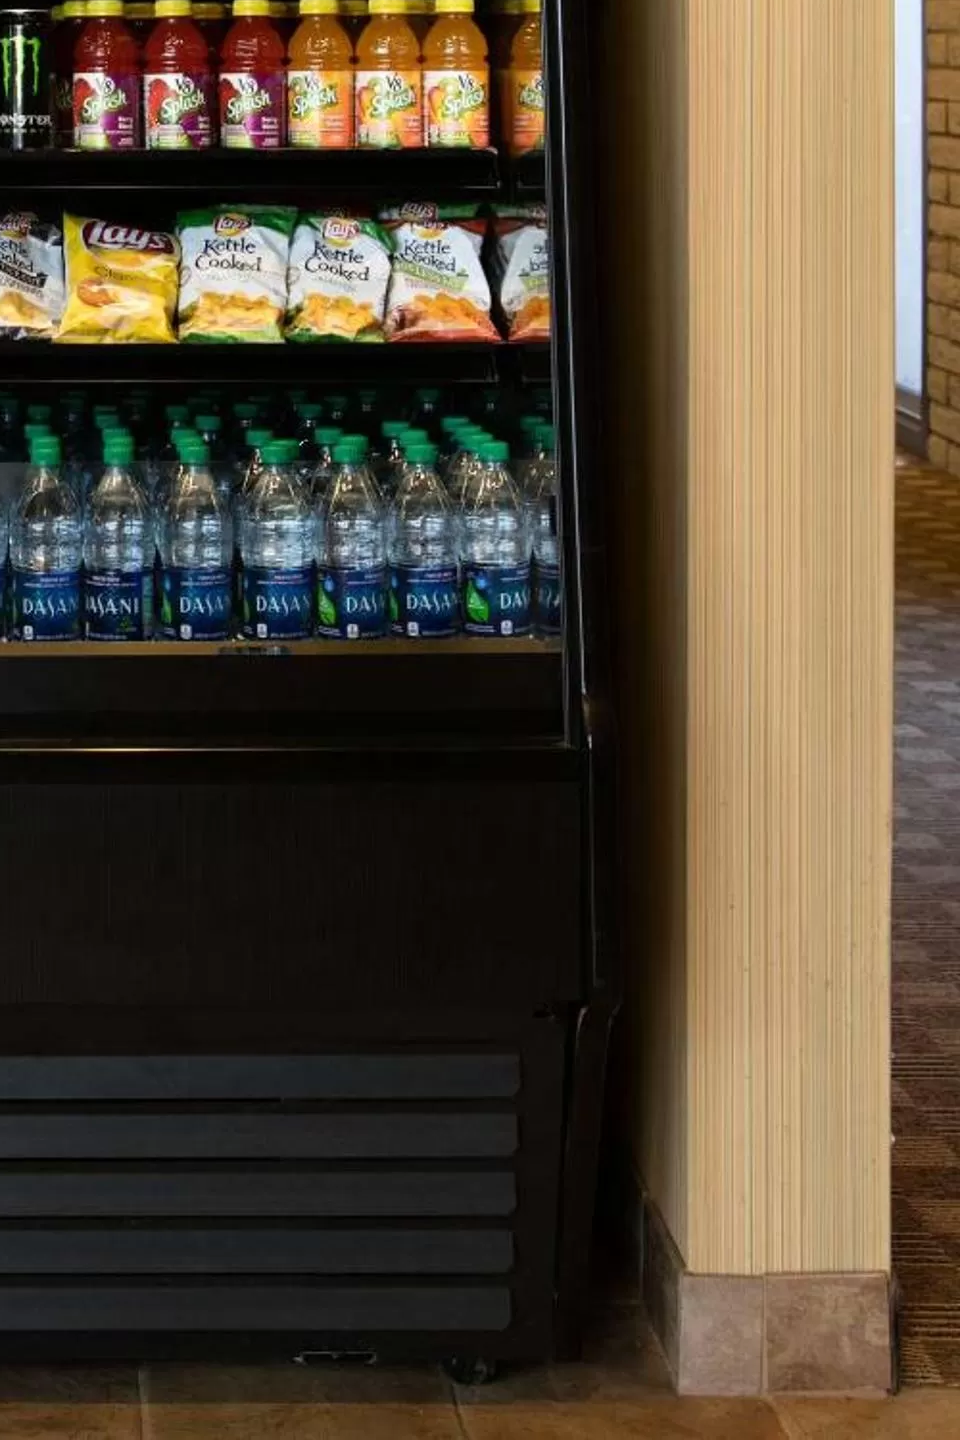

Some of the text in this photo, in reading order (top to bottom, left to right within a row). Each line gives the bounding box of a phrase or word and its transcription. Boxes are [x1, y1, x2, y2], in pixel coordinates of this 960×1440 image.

[202, 238, 256, 257] Kettle
[313, 239, 364, 264] Kettle
[403, 238, 451, 256] Kettle
[195, 254, 262, 273] Cooked
[305, 254, 370, 281] Cooked
